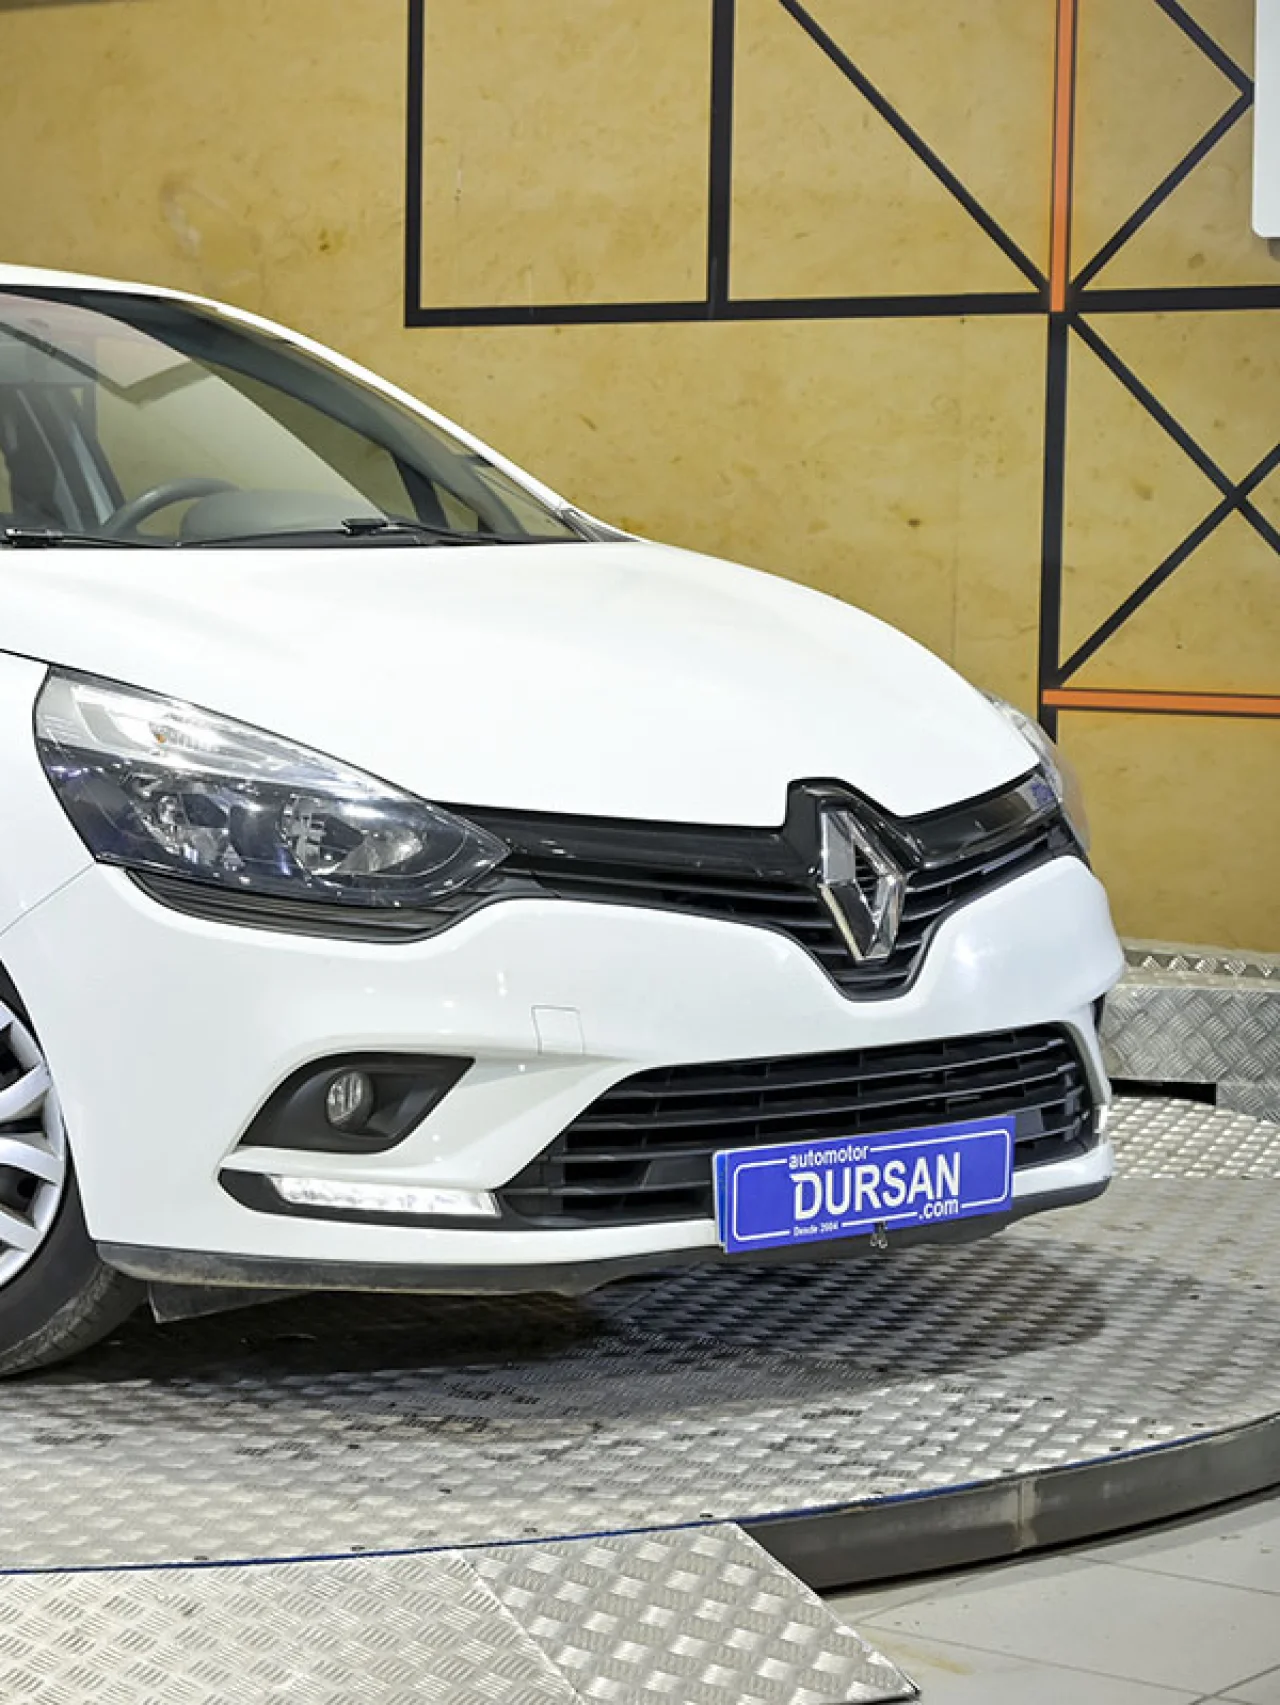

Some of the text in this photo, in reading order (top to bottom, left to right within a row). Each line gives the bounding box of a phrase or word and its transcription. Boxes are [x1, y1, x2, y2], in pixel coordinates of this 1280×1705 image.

[788, 1145, 869, 1169] automotor
[789, 1151, 961, 1221] DURSAN
[919, 1198, 960, 1220] .com
